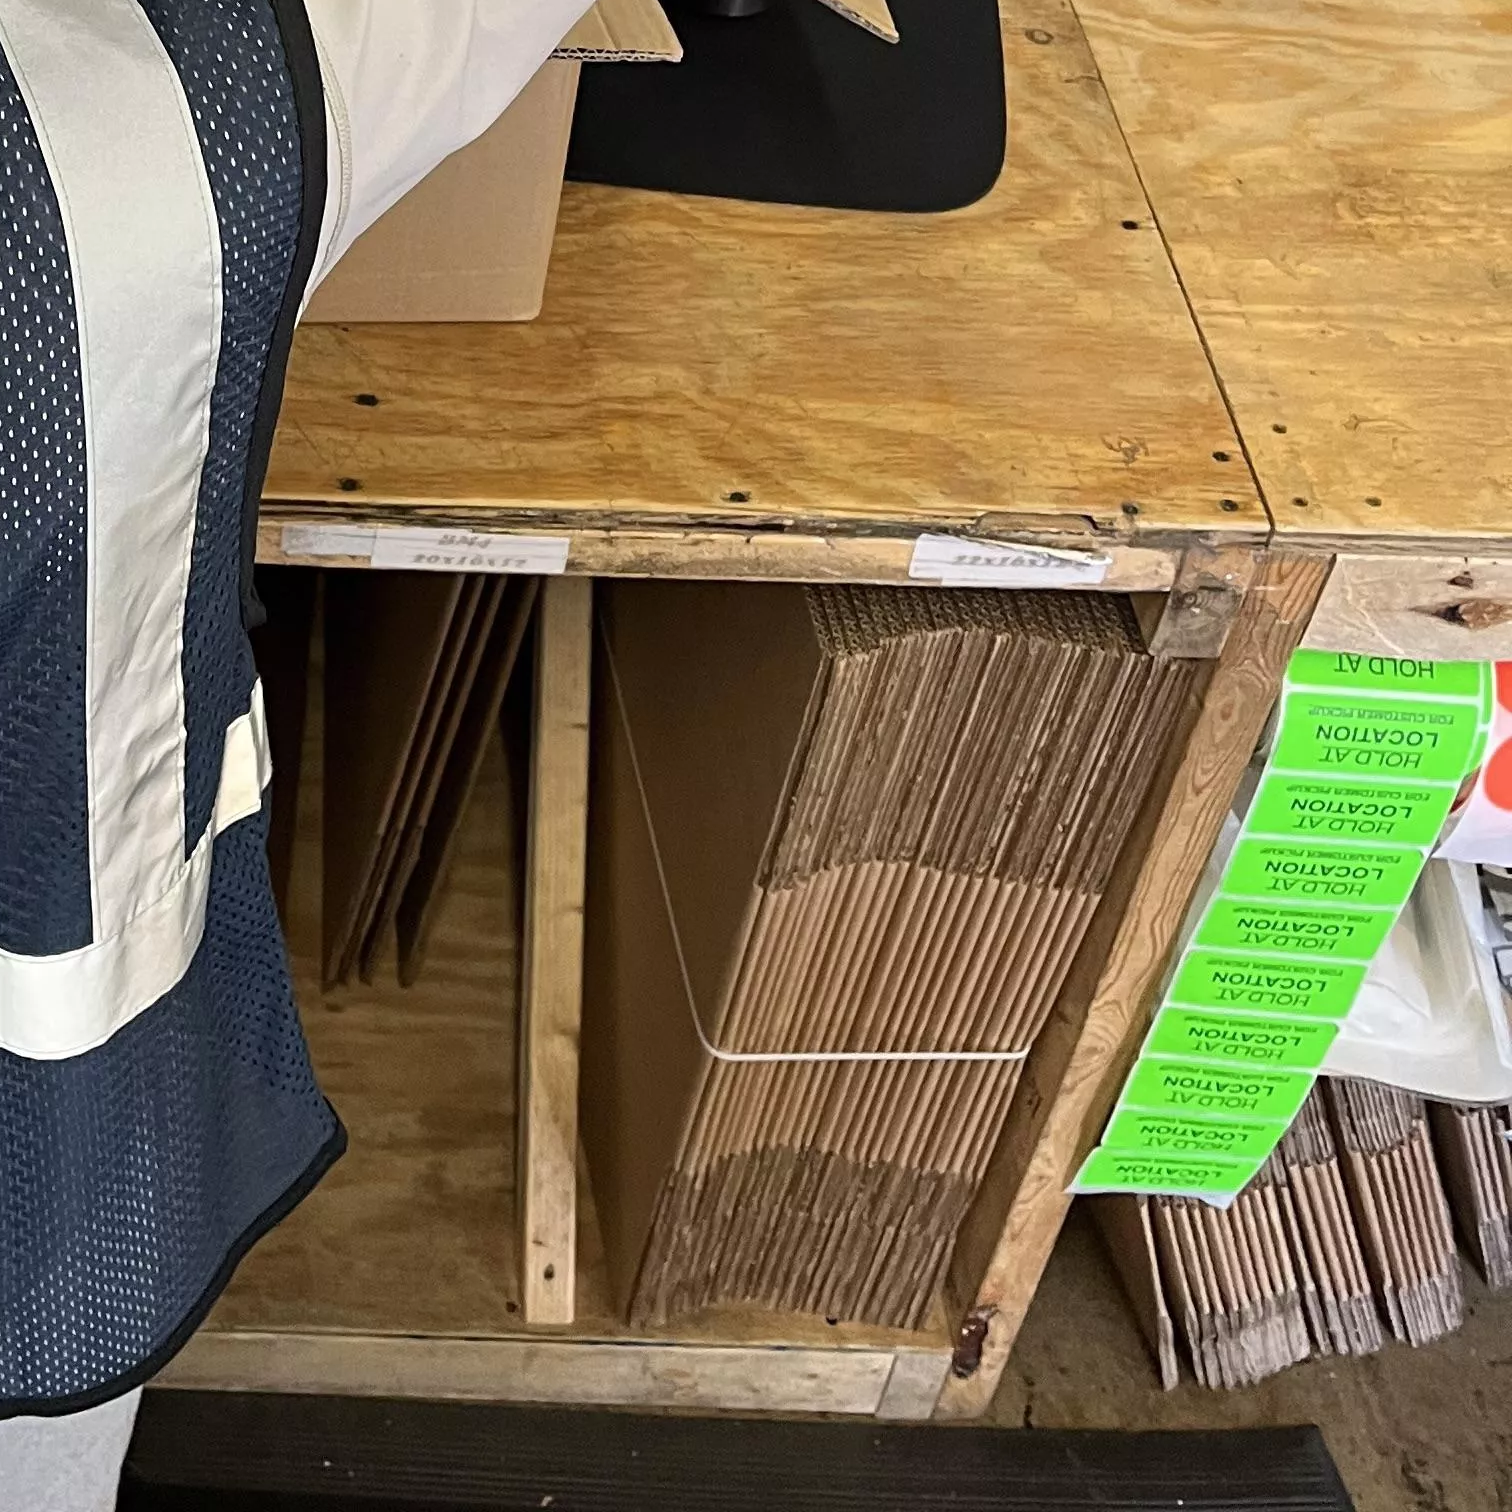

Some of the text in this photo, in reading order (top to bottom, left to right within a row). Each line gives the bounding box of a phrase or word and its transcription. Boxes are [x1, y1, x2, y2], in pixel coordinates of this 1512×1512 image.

[1334, 652, 1435, 679] HOLD AT
[1316, 724, 1439, 748] LOCATION
[1318, 746, 1424, 769] HOLD AT
[1291, 798, 1413, 819] LOCATION
[1291, 814, 1396, 834] HOLD AT
[1264, 860, 1384, 881] LOCATION
[1265, 876, 1367, 897] HOLD AT
[1237, 917, 1355, 937] LOCATION
[1239, 931, 1338, 950] HOLD AT
[1211, 971, 1327, 993] LOCATION
[1215, 986, 1312, 1007] HOLD AT
[1188, 1026, 1302, 1046] LOCATION
[1191, 1039, 1287, 1060] HOLD AT
[1163, 1075, 1274, 1097] LOCATION
[1165, 1090, 1259, 1110] HOLD AT
[1140, 1124, 1249, 1142] LOCATION
